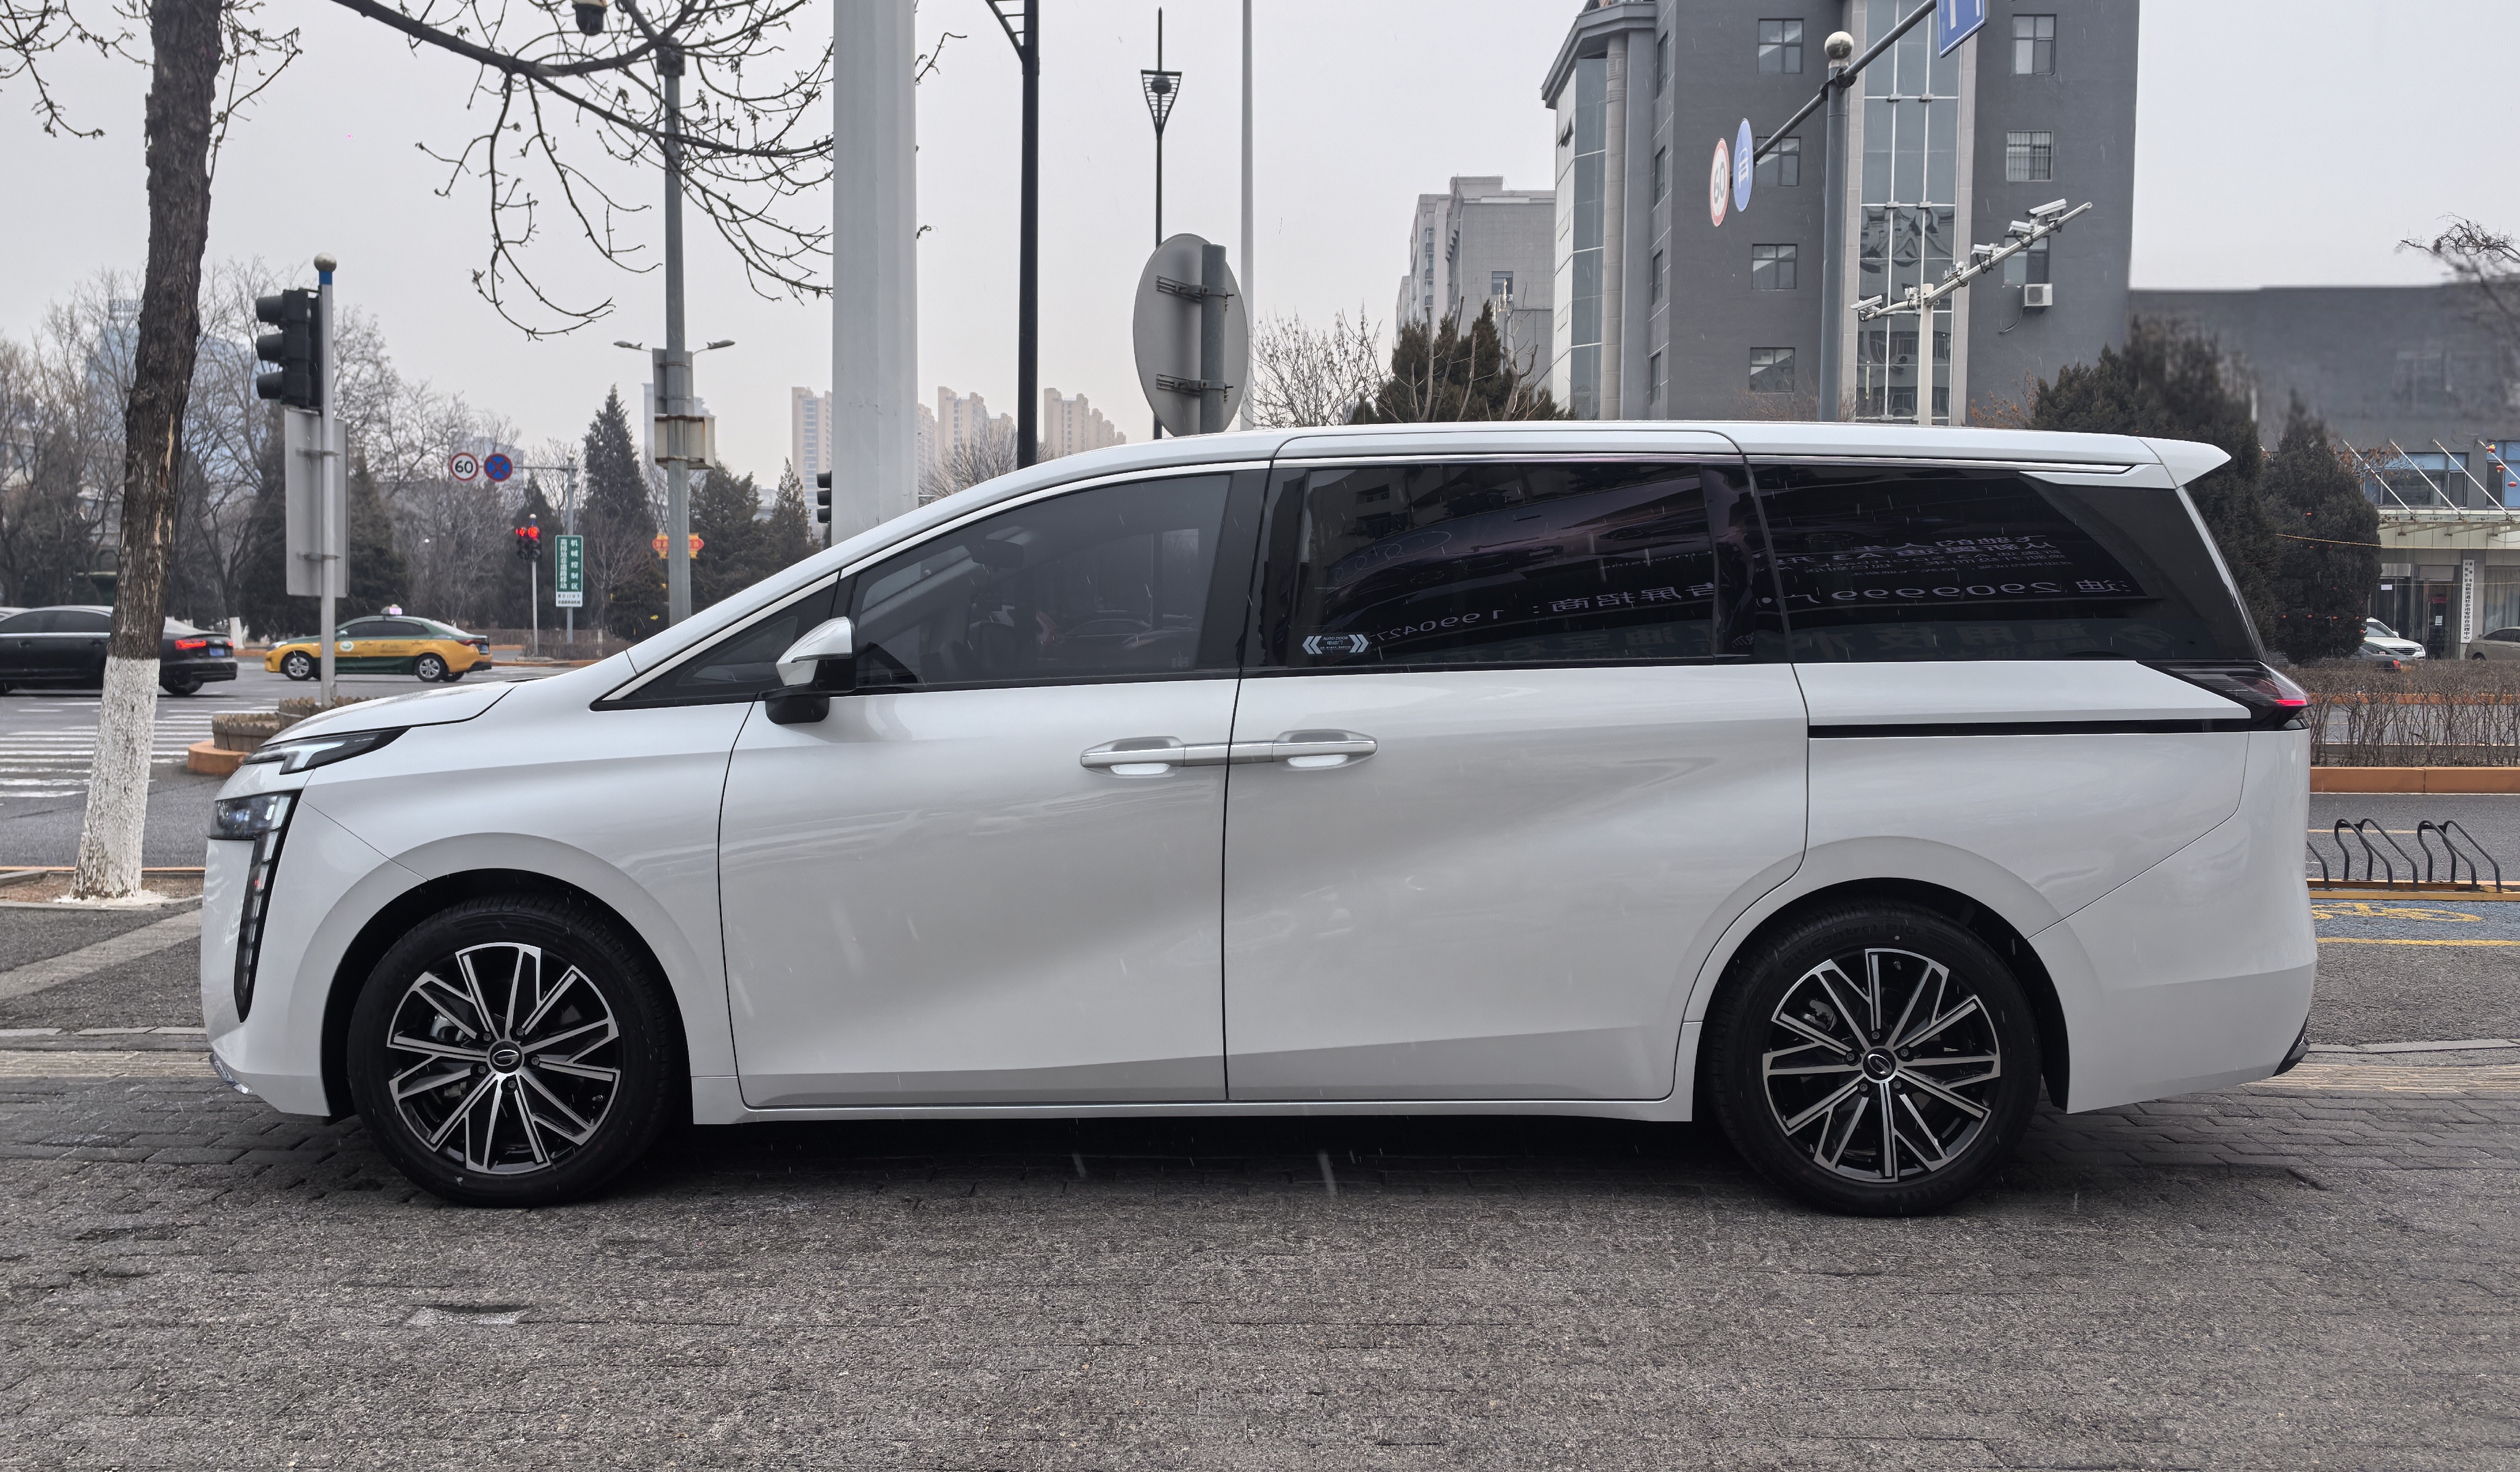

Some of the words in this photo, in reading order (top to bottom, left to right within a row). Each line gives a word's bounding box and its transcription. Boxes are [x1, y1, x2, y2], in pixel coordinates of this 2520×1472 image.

[1713, 161, 1726, 204] 60
[455, 461, 474, 474] 60
[570, 539, 579, 590] 机械控制区
